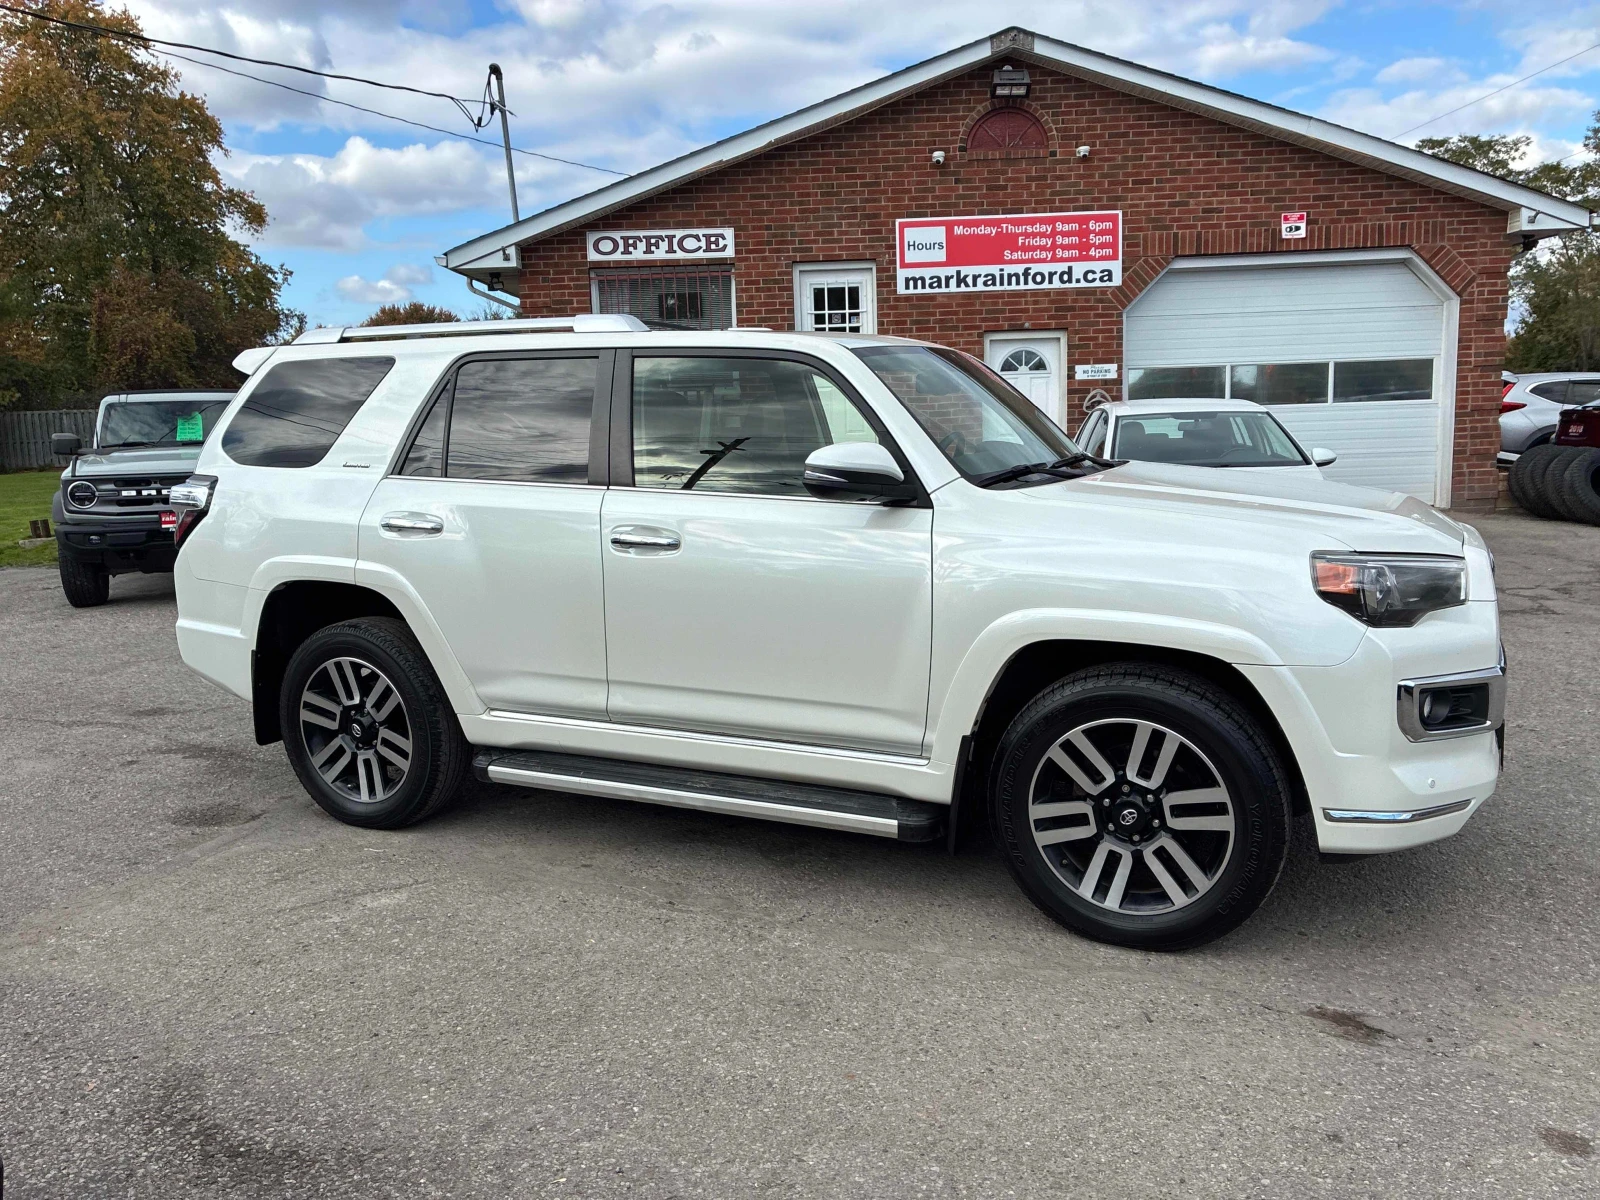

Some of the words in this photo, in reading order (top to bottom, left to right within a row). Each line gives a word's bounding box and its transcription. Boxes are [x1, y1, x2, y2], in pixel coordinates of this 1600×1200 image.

[954, 222, 1052, 236] Monday-Thursday
[1055, 222, 1079, 232] 9am
[1088, 220, 1113, 233] 6pm
[592, 233, 728, 256] OFFICE
[907, 240, 945, 251] Hours
[1018, 235, 1052, 247] Friday
[1055, 235, 1079, 245] 9am
[1088, 234, 1113, 245] 5pm
[1004, 248, 1052, 261] Saturday
[1055, 248, 1079, 258] 9am
[1088, 247, 1113, 259] 4pm
[904, 266, 1114, 290] markrainford.ca
